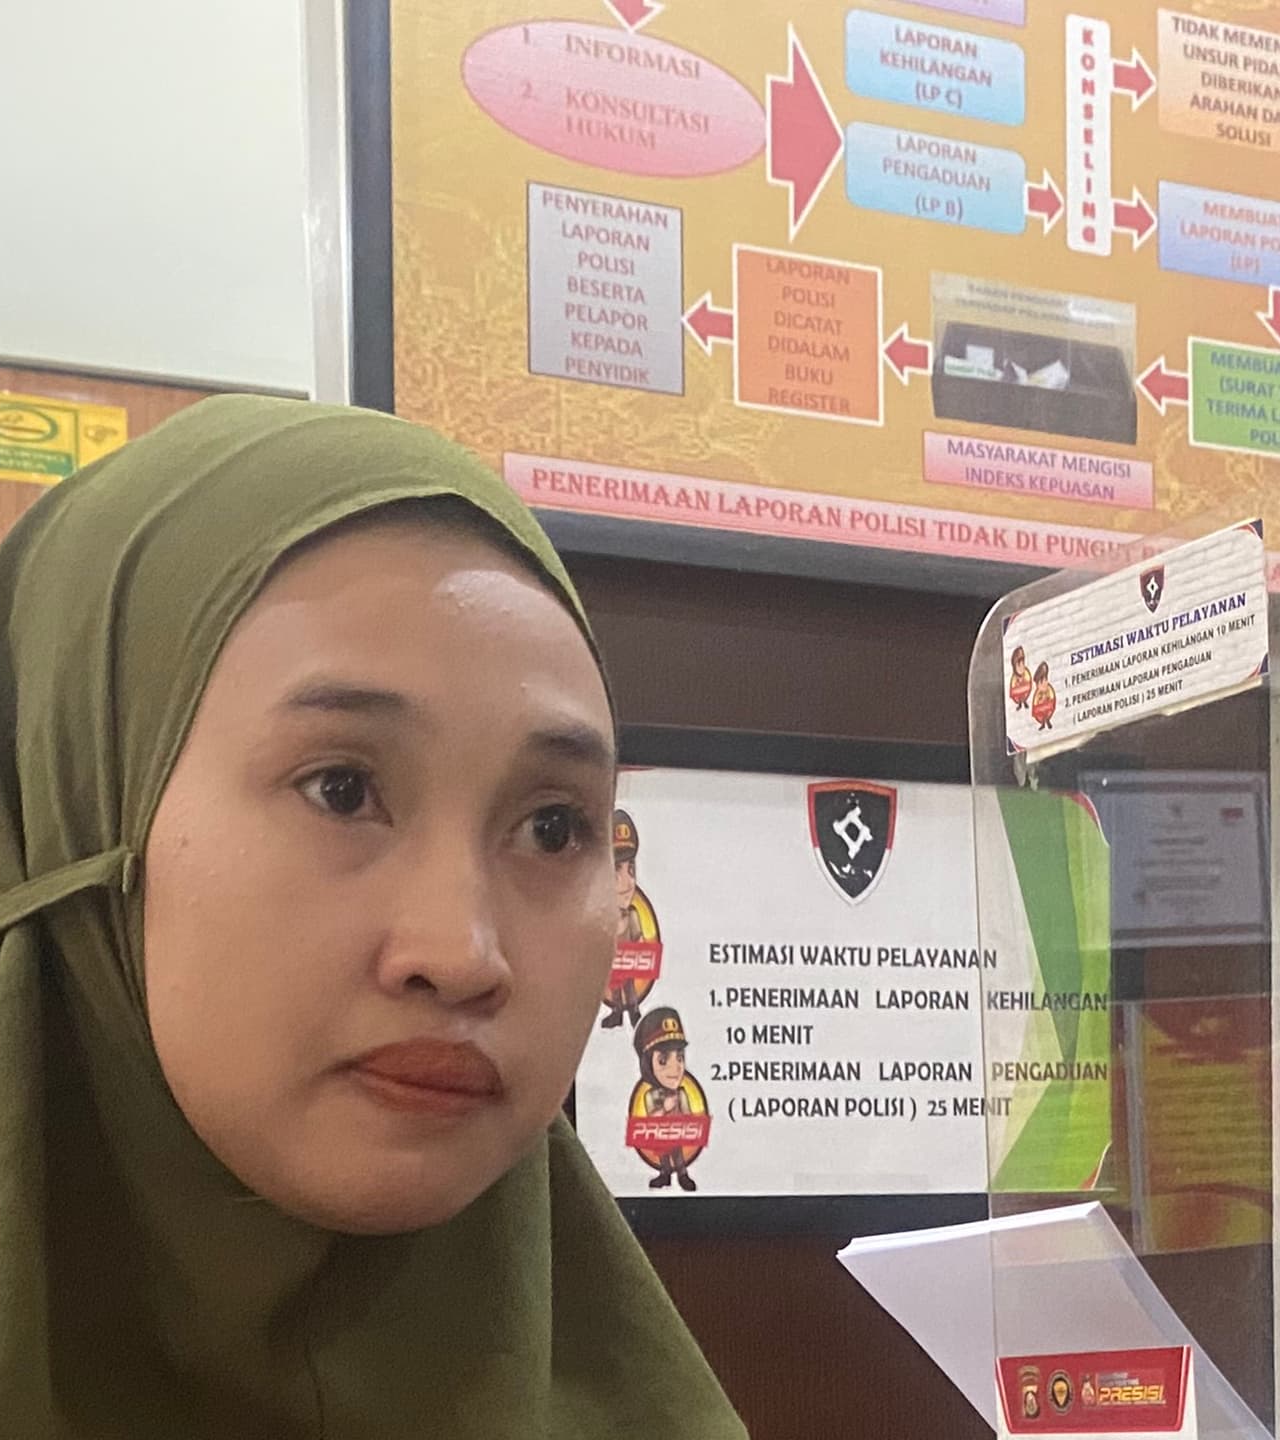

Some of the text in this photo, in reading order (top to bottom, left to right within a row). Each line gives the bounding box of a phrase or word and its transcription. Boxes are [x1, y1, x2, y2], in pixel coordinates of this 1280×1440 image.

[895, 24, 978, 58] LAPORAN
[1172, 15, 1220, 43] TIDAK
[564, 33, 701, 80] INFORMASI
[879, 49, 992, 87] KEHILANGAN
[1183, 43, 1239, 74] UNSUR
[915, 80, 963, 109] (LP C)
[1190, 93, 1258, 123] ARAHAN
[565, 88, 710, 134] KONSULTASI
[564, 115, 657, 151] HUKUM
[1216, 123, 1272, 147] SOLUSI
[896, 134, 977, 165] LAPORAN
[882, 156, 991, 193] PENGADUAN
[541, 189, 669, 230] PENYERAHAN
[915, 191, 940, 215] (LP
[561, 219, 651, 253] LAPORAN
[1180, 222, 1257, 253] LAPORAN
[577, 250, 636, 276] POLISI
[766, 257, 851, 286] LAPORAN
[567, 276, 646, 304] BESERTA
[781, 284, 837, 309] POLISI
[564, 302, 649, 332] PELAPOR
[773, 309, 843, 336] DICATAT
[570, 331, 644, 358] KEPADA
[767, 335, 851, 364] DIDALAM
[564, 357, 651, 385] PENYIDIK
[784, 362, 834, 387] BUKU
[767, 387, 851, 415] REGISTER
[1220, 376, 1275, 400] (SURAT
[1207, 398, 1267, 421] TERIMA
[946, 438, 1132, 480] MASYARAKAT MENGISI
[964, 466, 1115, 500] INDEKS KEPUASAN
[531, 467, 711, 512] PENERIMAAN
[717, 492, 842, 528] LAPORAN
[849, 510, 927, 539] POLISI
[933, 519, 1008, 550] TIDAK
[1015, 530, 1039, 551] DI
[1070, 592, 1247, 666] ESTIMASI WAKTU PELAYANAN
[1071, 659, 1121, 686] PENERIMAAN
[1121, 649, 1159, 670] LAPORAN
[1160, 627, 1215, 657] KEHILANGAN
[1216, 624, 1227, 638] 10
[1227, 613, 1256, 634] MENIT
[1072, 679, 1121, 706] PENERIMAAN
[1122, 667, 1160, 689] LAPORAN
[1161, 650, 1213, 676] PENGADUAN
[1146, 688, 1157, 701] 25
[1157, 679, 1184, 697] MENIT
[611, 950, 657, 972] ESISI
[709, 943, 997, 969] ESTIMASI WAKTU PELAYANAN
[875, 989, 970, 1010] LAPORAN
[986, 990, 1108, 1012] KEHILANGAN
[726, 1024, 814, 1045] 10 MENIT
[878, 1061, 972, 1082] LAPORAN
[991, 1061, 1108, 1082] PENGADUAN
[927, 1099, 948, 1118] 25
[952, 1097, 1013, 1118] MENIT
[631, 1121, 705, 1141] PRESISI
[1098, 1384, 1165, 1402] PRESISI
